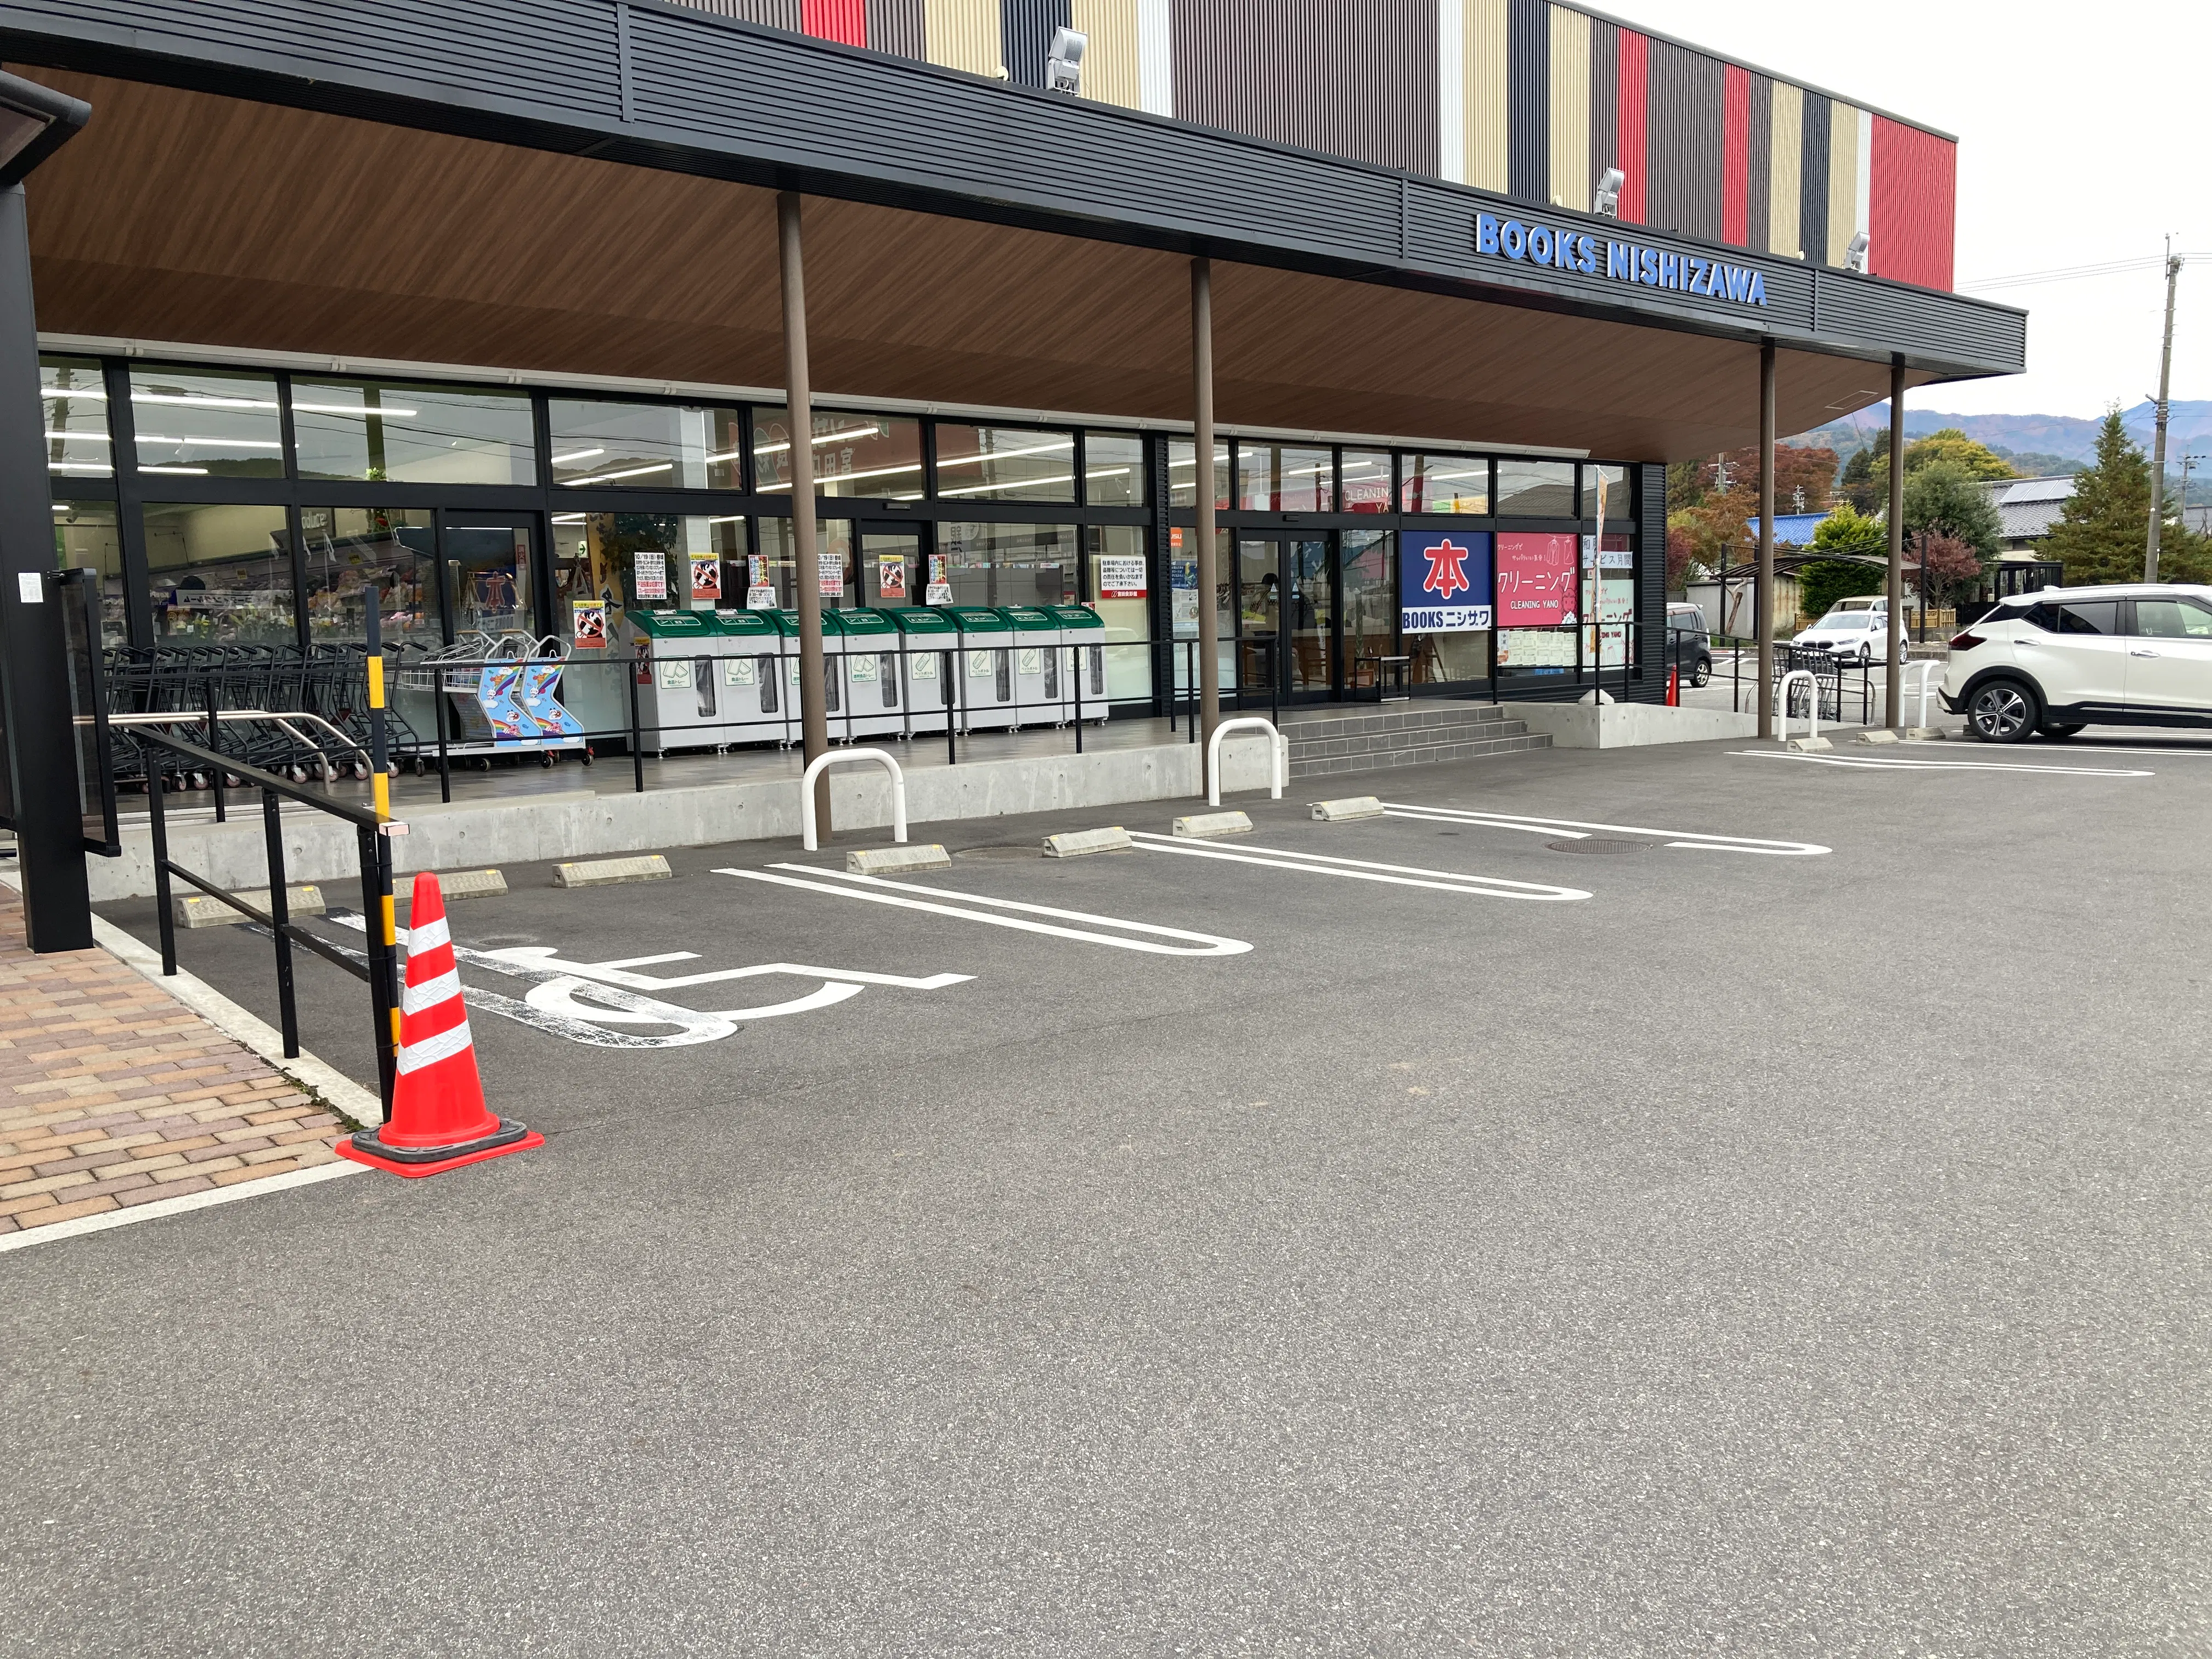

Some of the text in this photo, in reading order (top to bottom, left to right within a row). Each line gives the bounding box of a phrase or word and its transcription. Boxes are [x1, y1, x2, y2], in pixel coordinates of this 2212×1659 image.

[1476, 213, 1768, 306] BOOKS NISHIZAWA
[1423, 538, 1469, 600] 本
[1498, 566, 1575, 593] クリーニング
[1510, 600, 1559, 610] CLEANING YANO
[1403, 611, 1443, 629] BOOKS
